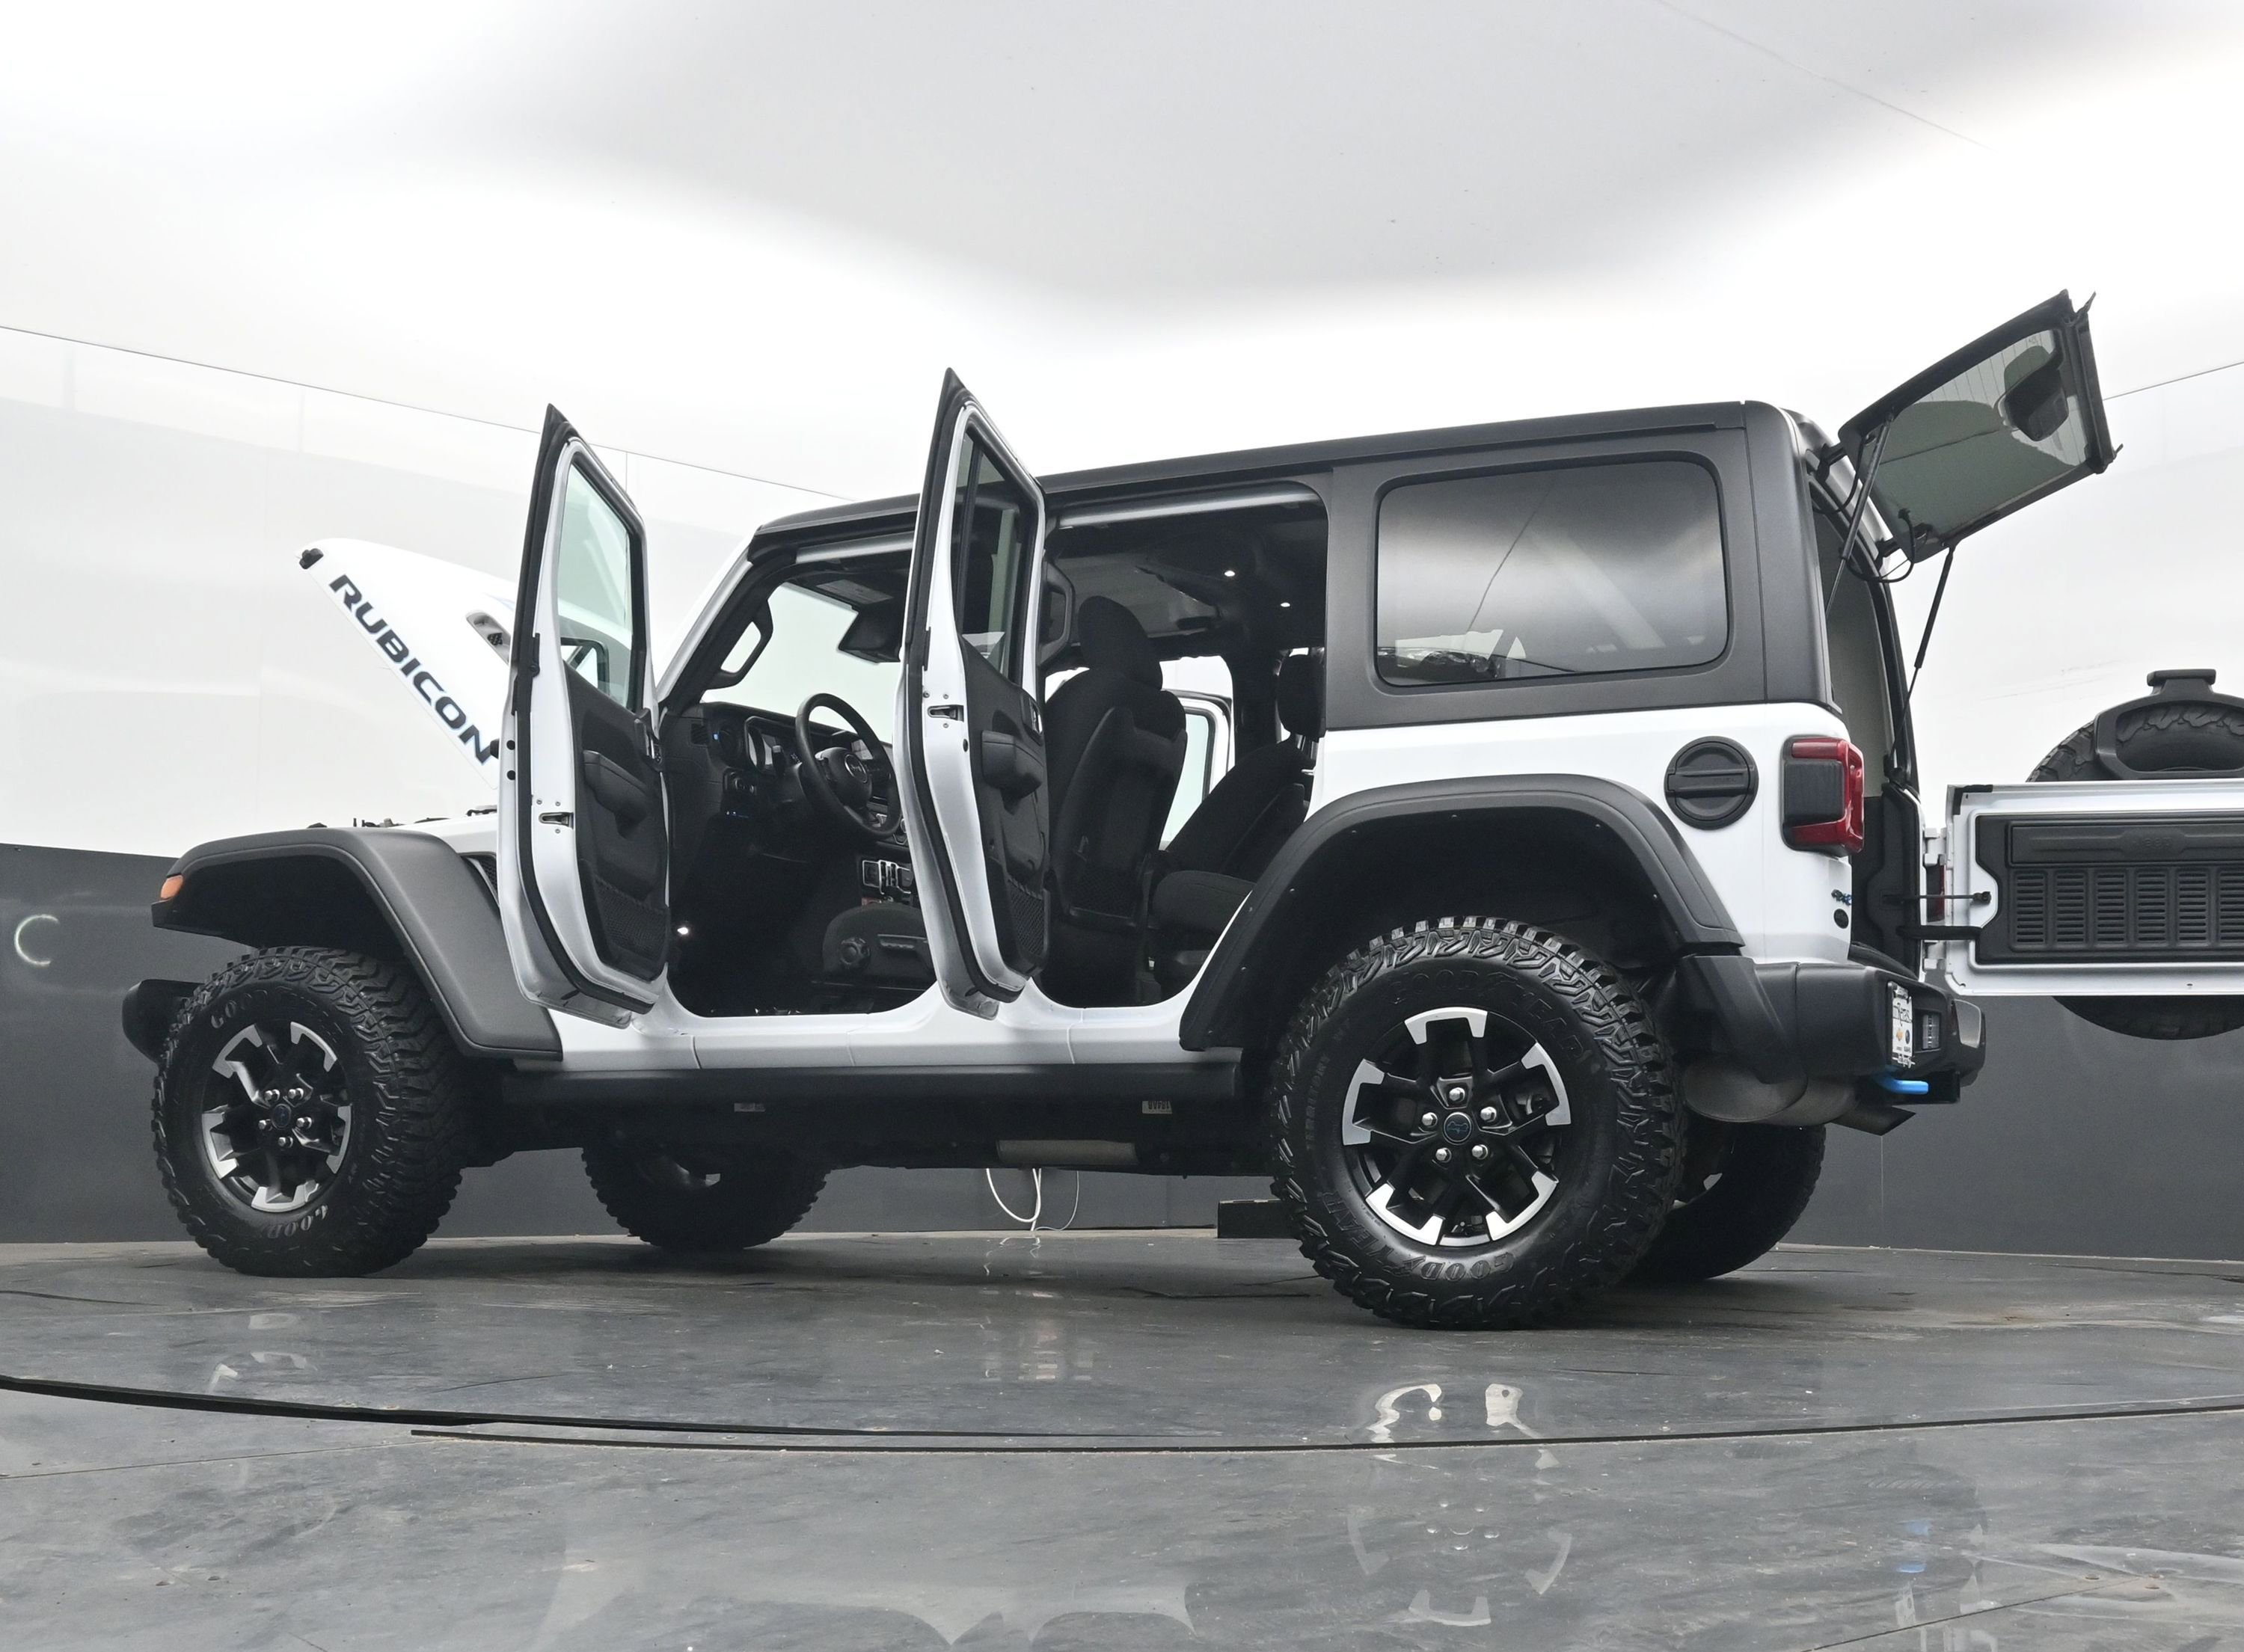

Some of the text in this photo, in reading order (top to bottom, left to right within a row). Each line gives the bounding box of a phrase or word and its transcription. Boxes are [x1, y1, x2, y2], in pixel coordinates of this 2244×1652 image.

[328, 574, 492, 765] RUBICON
[1389, 969, 1585, 1059] GOODYEAR
[1321, 1190, 1515, 1282] GOODYEAR
